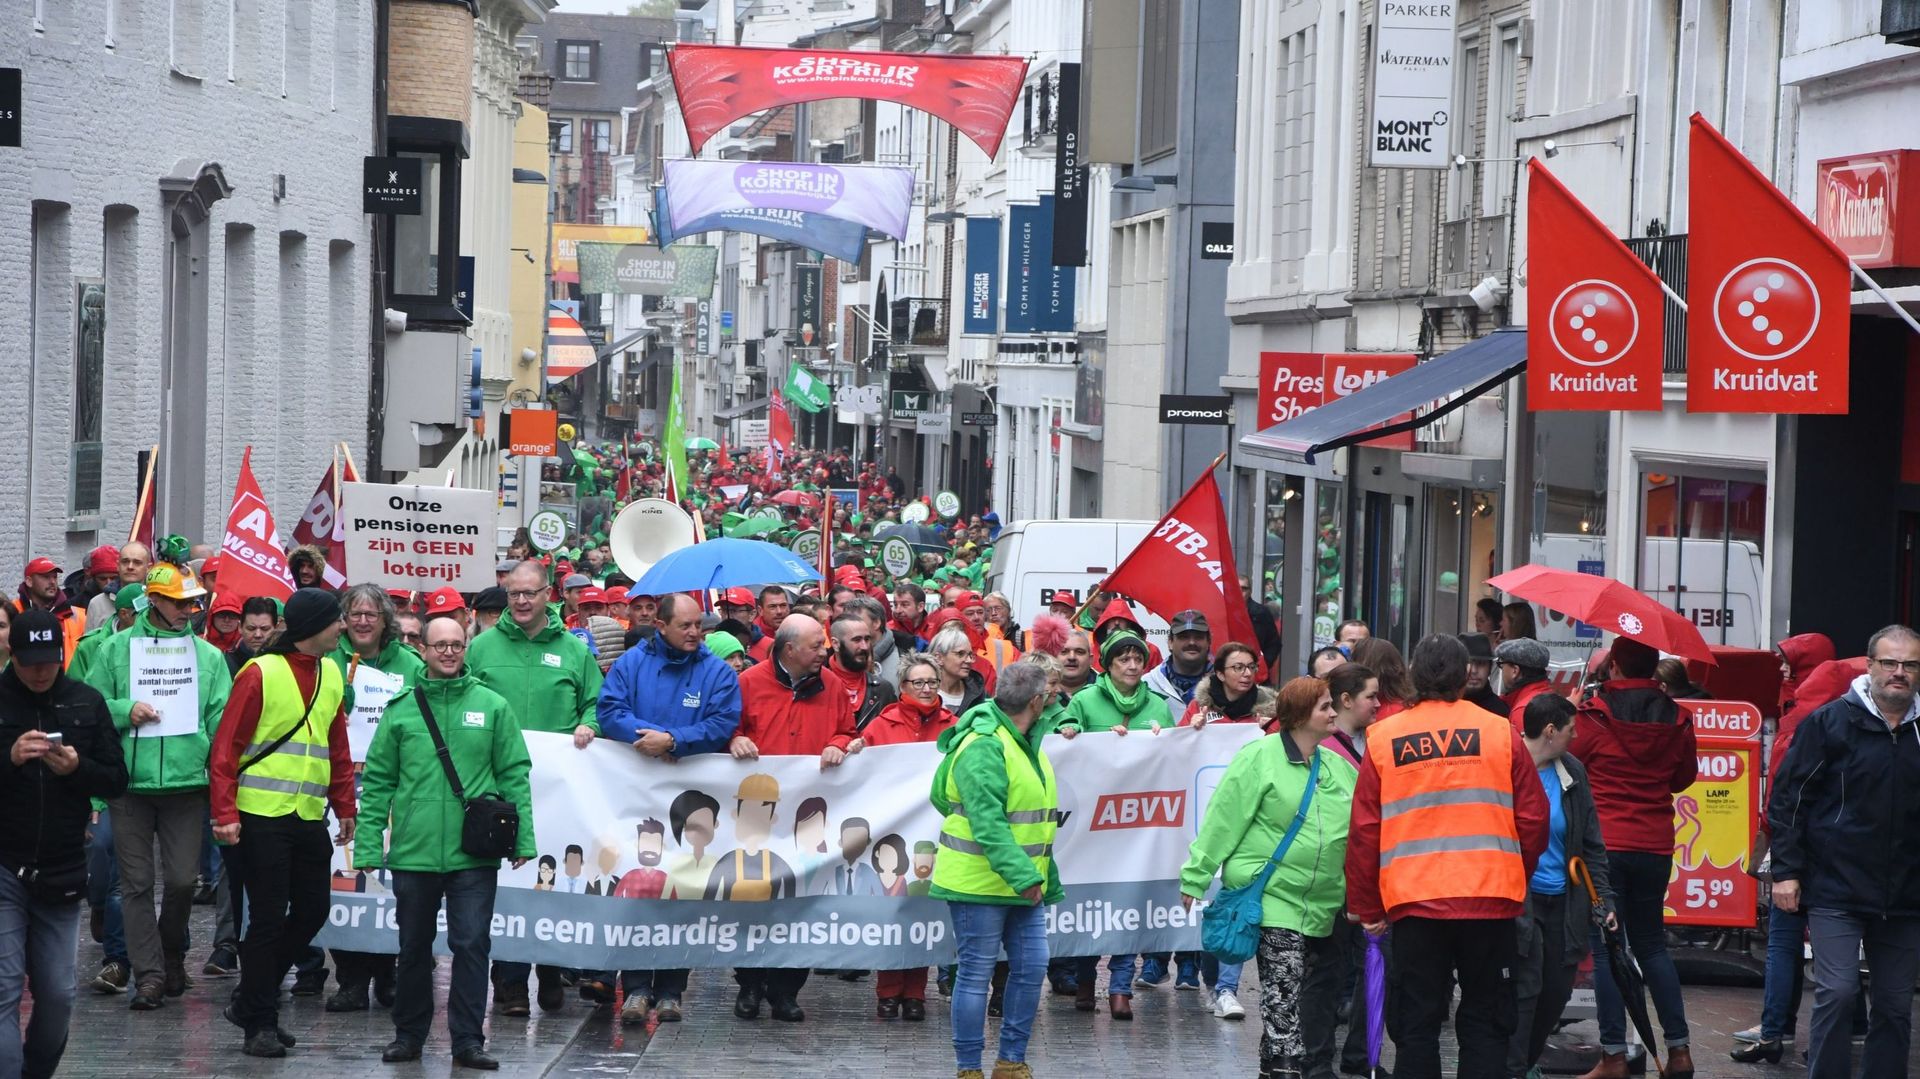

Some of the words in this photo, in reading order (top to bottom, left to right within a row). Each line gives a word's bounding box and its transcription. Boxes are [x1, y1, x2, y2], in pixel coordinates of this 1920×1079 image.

[1385, 3, 1451, 17] PARKER
[1381, 49, 1450, 66] WATERMAN
[773, 65, 919, 81] KORTRIJK
[776, 75, 914, 88] www.shopinkortrijk.be
[1378, 120, 1433, 136] MONT
[1377, 137, 1432, 153] BLANC
[757, 168, 813, 180] SHOP
[1064, 132, 1076, 199] SELECTED
[367, 187, 418, 195] XANDRES
[740, 176, 837, 195] KORTRIJK
[1840, 182, 1884, 238] Kruidvat
[1023, 222, 1032, 265] HILFIGER
[1205, 244, 1234, 253] CALZ
[628, 258, 662, 270] SHOP
[662, 259, 676, 270] IN
[617, 267, 674, 280] KORTRIJK
[981, 272, 989, 300] DENIM
[1051, 273, 1061, 314] TOMMY
[973, 273, 983, 319] HILFIGER
[1021, 278, 1029, 316] TOMMY
[1273, 366, 1324, 394] Pres
[1549, 372, 1638, 392] Kruidvat
[1713, 367, 1818, 392] Kruidvat
[1167, 408, 1223, 418] promod
[921, 418, 944, 427] Gabor
[512, 443, 551, 455] orange
[389, 496, 442, 513] Onze
[939, 495, 953, 507] 60
[354, 518, 479, 535] pensioenen
[538, 517, 560, 535] 65
[368, 538, 405, 555] zijn
[412, 540, 474, 556] GEEN
[798, 537, 819, 553] 65
[889, 544, 905, 560] 65
[383, 559, 461, 582] loterij!
[29, 630, 53, 642] K9
[137, 678, 161, 686] aantal
[1692, 708, 1751, 731] idvat
[1400, 728, 1474, 761] ABVV
[1697, 755, 1737, 778] MO!
[1098, 796, 1182, 826] ABVV
[329, 902, 367, 928] or
[534, 917, 594, 945] een
[604, 915, 740, 953] waardig
[746, 912, 902, 952] pensioen
[909, 919, 945, 950] op
